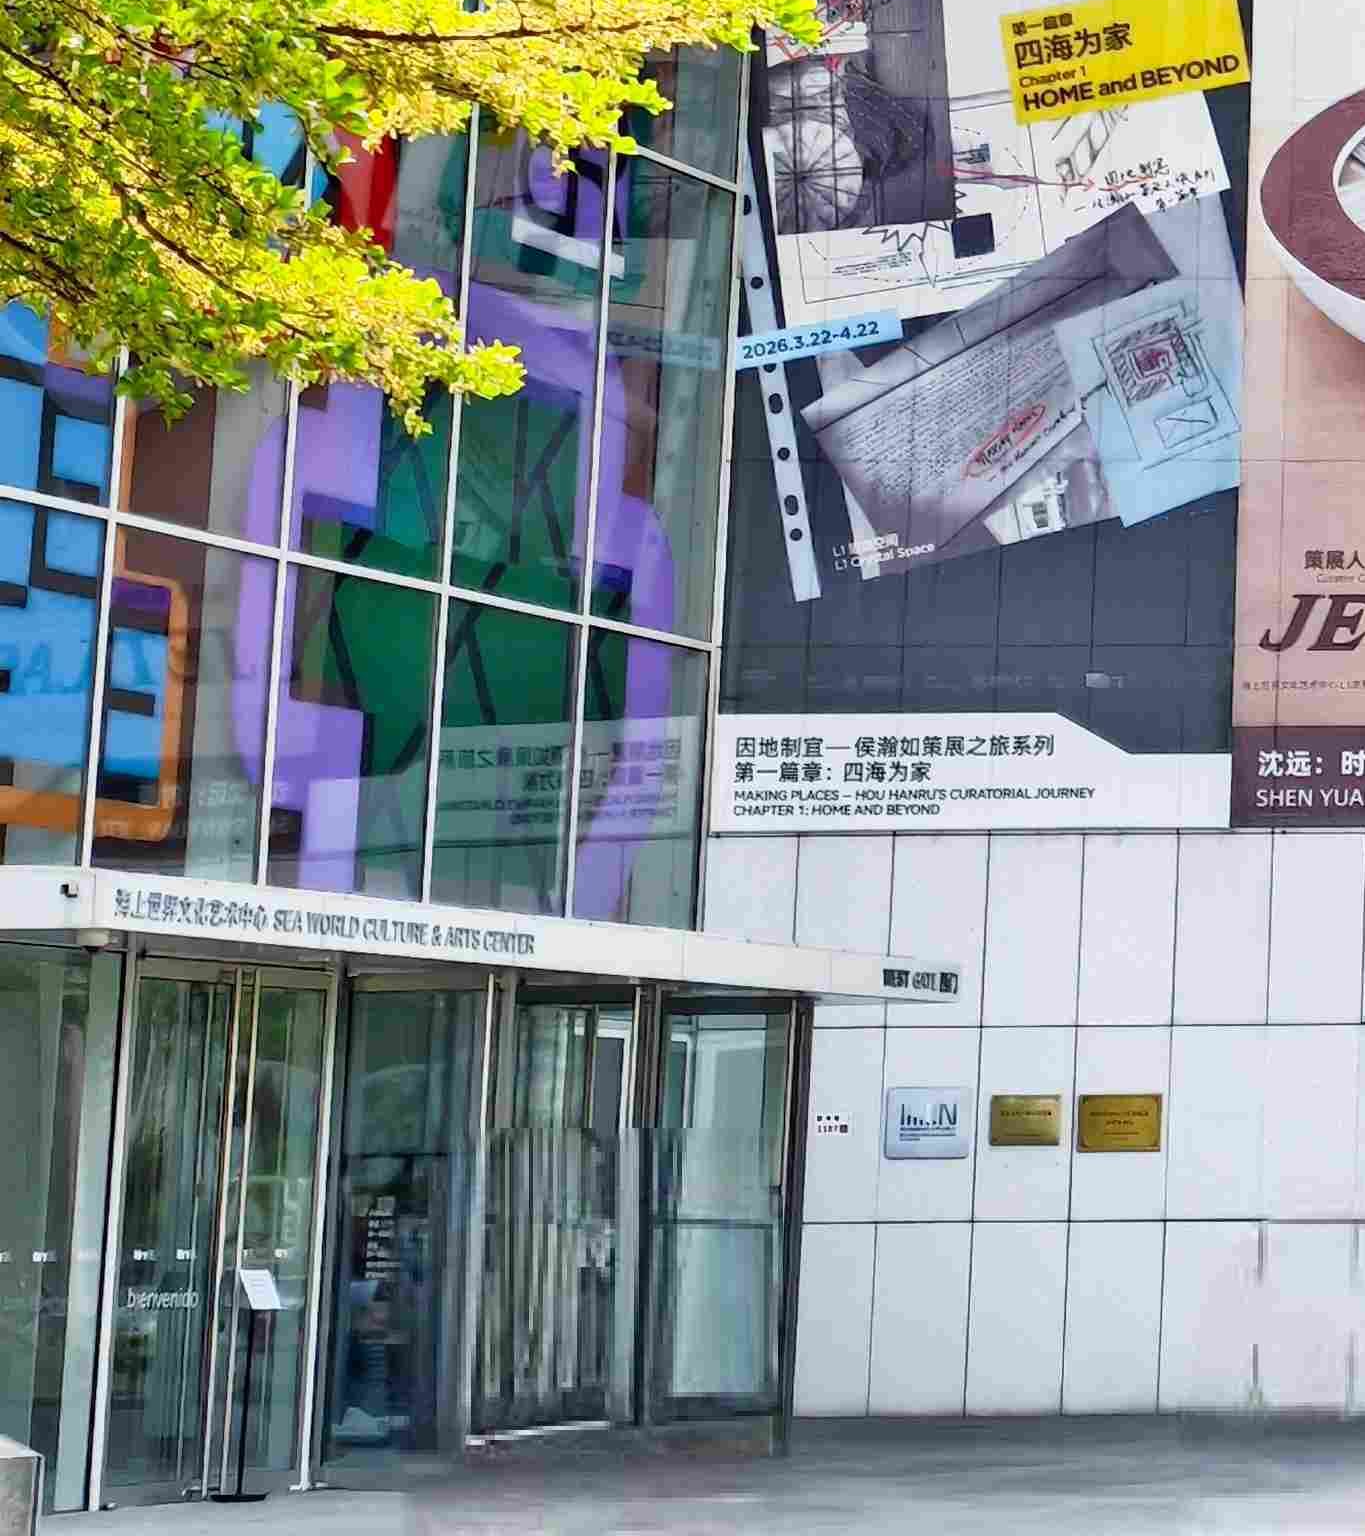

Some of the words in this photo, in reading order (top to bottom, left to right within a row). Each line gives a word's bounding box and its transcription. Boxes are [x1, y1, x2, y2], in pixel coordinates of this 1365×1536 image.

[1014, 22, 1133, 70] 四海为家
[1019, 68, 1077, 89] Chapter
[1081, 65, 1087, 77] 1
[1023, 81, 1095, 111] HOME
[1098, 73, 1137, 97] and
[1141, 54, 1240, 89] BEYOND
[742, 321, 880, 360] 2026.3.22-4.22
[734, 789, 788, 801] MAKING
[790, 789, 840, 801] PLACES
[855, 789, 887, 801] HOU
[949, 788, 1033, 801] CURATORIAL
[1034, 787, 1096, 800] JOURNEY
[734, 804, 796, 816] CHAPTER
[811, 804, 851, 816] HOME
[853, 804, 884, 816] AND
[886, 803, 940, 815] BEYOND
[1256, 788, 1314, 807] SHEN
[273, 908, 303, 933] SEA
[306, 911, 360, 939] WORLD
[363, 917, 428, 946] CULTURE
[444, 925, 481, 950] ARTS
[483, 930, 535, 954] CENTER
